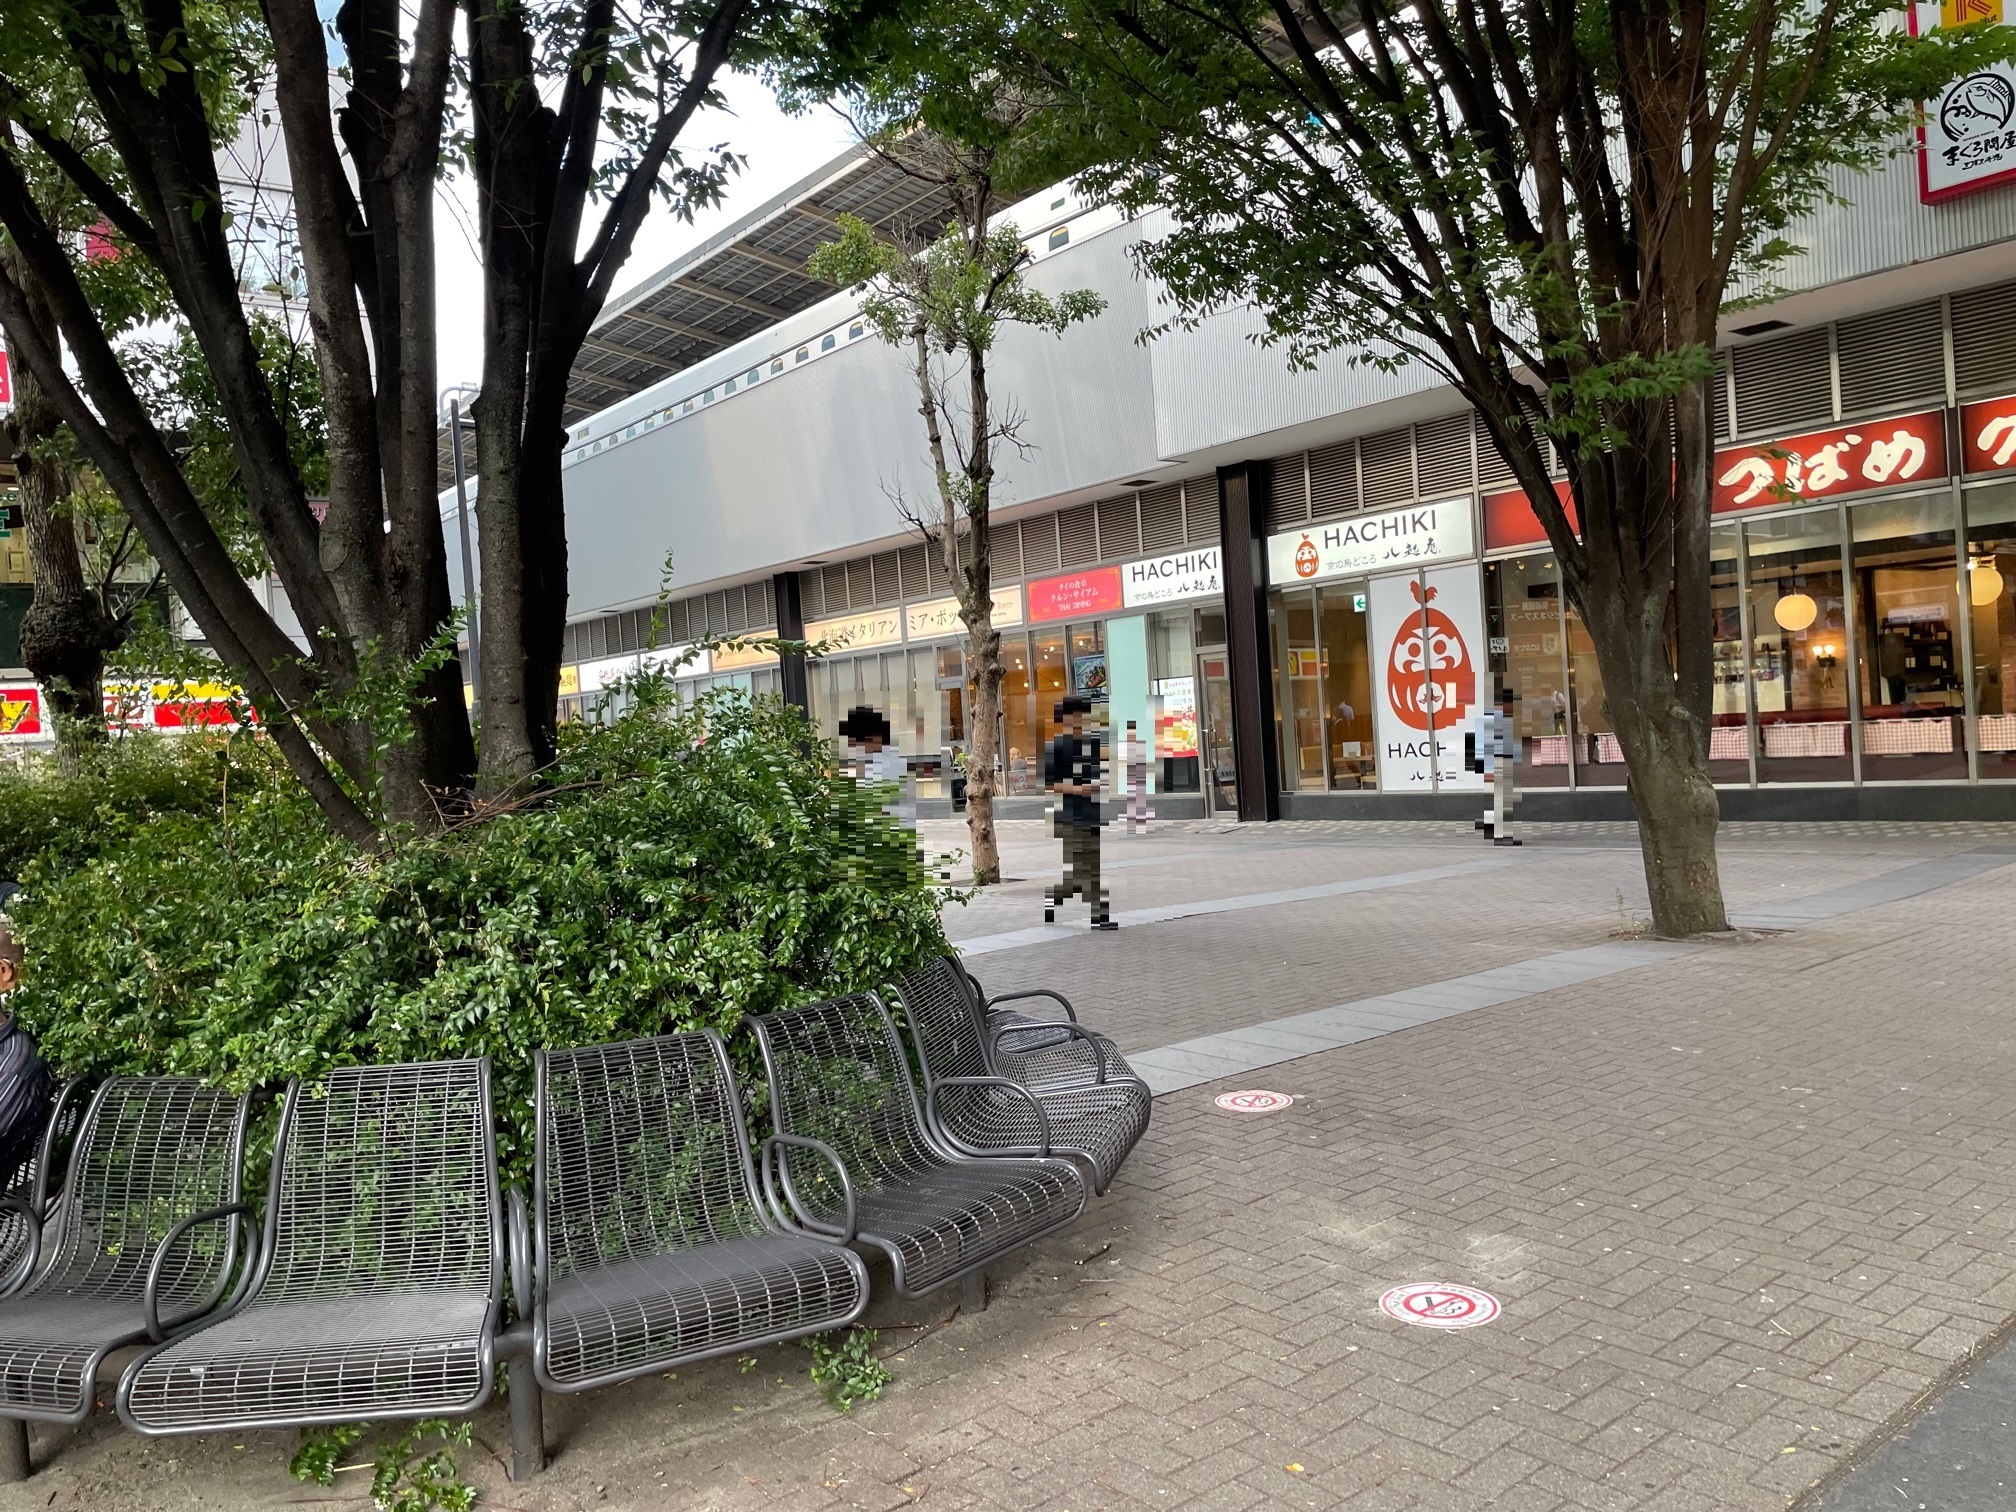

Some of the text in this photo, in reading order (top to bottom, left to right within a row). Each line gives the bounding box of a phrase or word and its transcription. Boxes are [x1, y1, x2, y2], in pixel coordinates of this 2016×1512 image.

[1717, 429, 1926, 504] つばめ
[1324, 509, 1437, 550] HACHIKI
[1131, 551, 1218, 583] HACHIKI
[1326, 555, 1377, 571] 京の鳥どころ
[910, 609, 962, 631] ミア・ボッ
[1058, 603, 1071, 612] THAI
